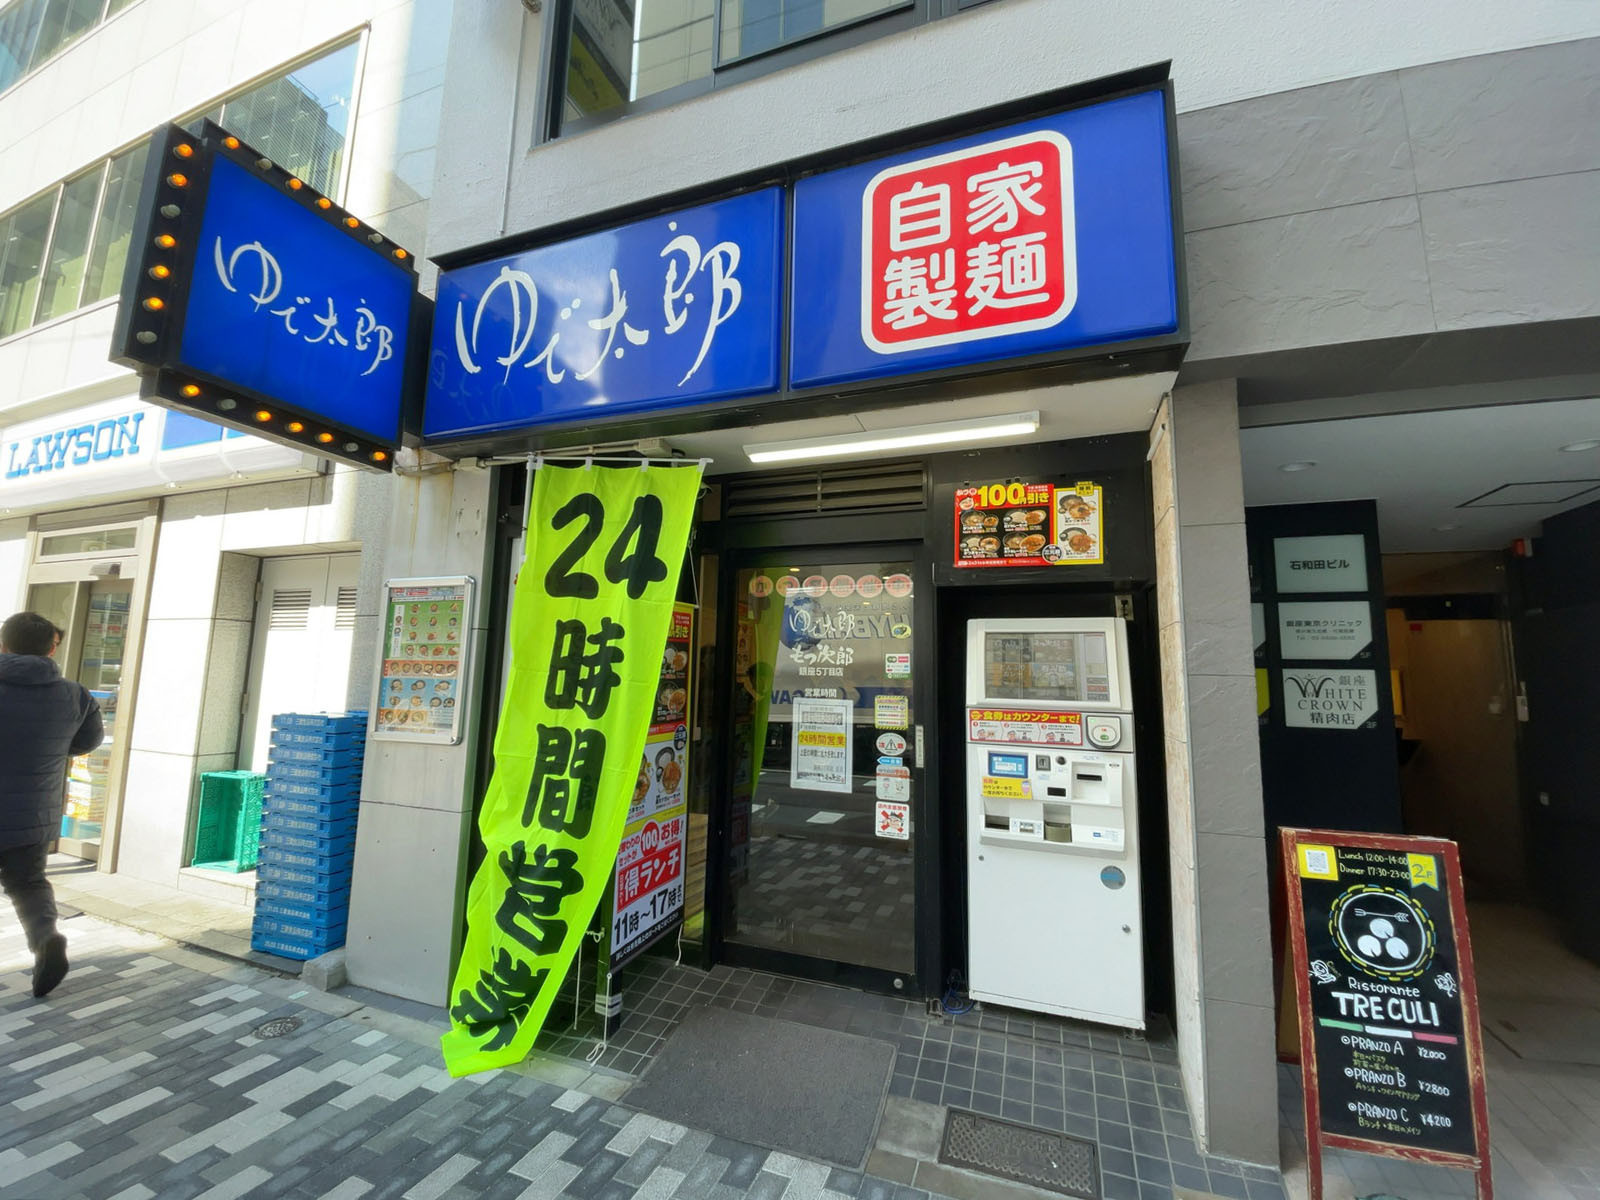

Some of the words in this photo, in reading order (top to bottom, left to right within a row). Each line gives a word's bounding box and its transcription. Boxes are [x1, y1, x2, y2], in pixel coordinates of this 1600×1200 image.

[889, 161, 1046, 253] 自家
[882, 231, 1050, 331] 製麺
[214, 236, 393, 376] ゆで太郎
[455, 221, 742, 387] ゆで太郎
[5, 412, 145, 479] LAWSON
[1289, 559, 1350, 570] 石和田ビル
[789, 607, 855, 641] ゆで太郎
[789, 644, 854, 667] もつ次郎
[1285, 674, 1367, 699] WHITE
[1339, 675, 1366, 686] 銀座
[1298, 699, 1363, 711] CROWN
[1310, 712, 1355, 725] 精肉店
[799, 733, 845, 746] 24時間営業
[451, 493, 668, 1052] 24時間営業
[1338, 849, 1363, 861] Lunch
[1339, 862, 1364, 875] Dinner
[1411, 863, 1433, 879] 2F
[1348, 976, 1420, 997] Ristorante
[1331, 991, 1385, 1020] TRE
[1387, 998, 1440, 1027] CULI
[1351, 1036, 1391, 1053] PRANZO
[1393, 1040, 1405, 1056] A
[1354, 1067, 1394, 1085] PRANZO
[1397, 1071, 1406, 1088] B
[1357, 1102, 1398, 1120] PRANZO
[1400, 1107, 1409, 1122] C
